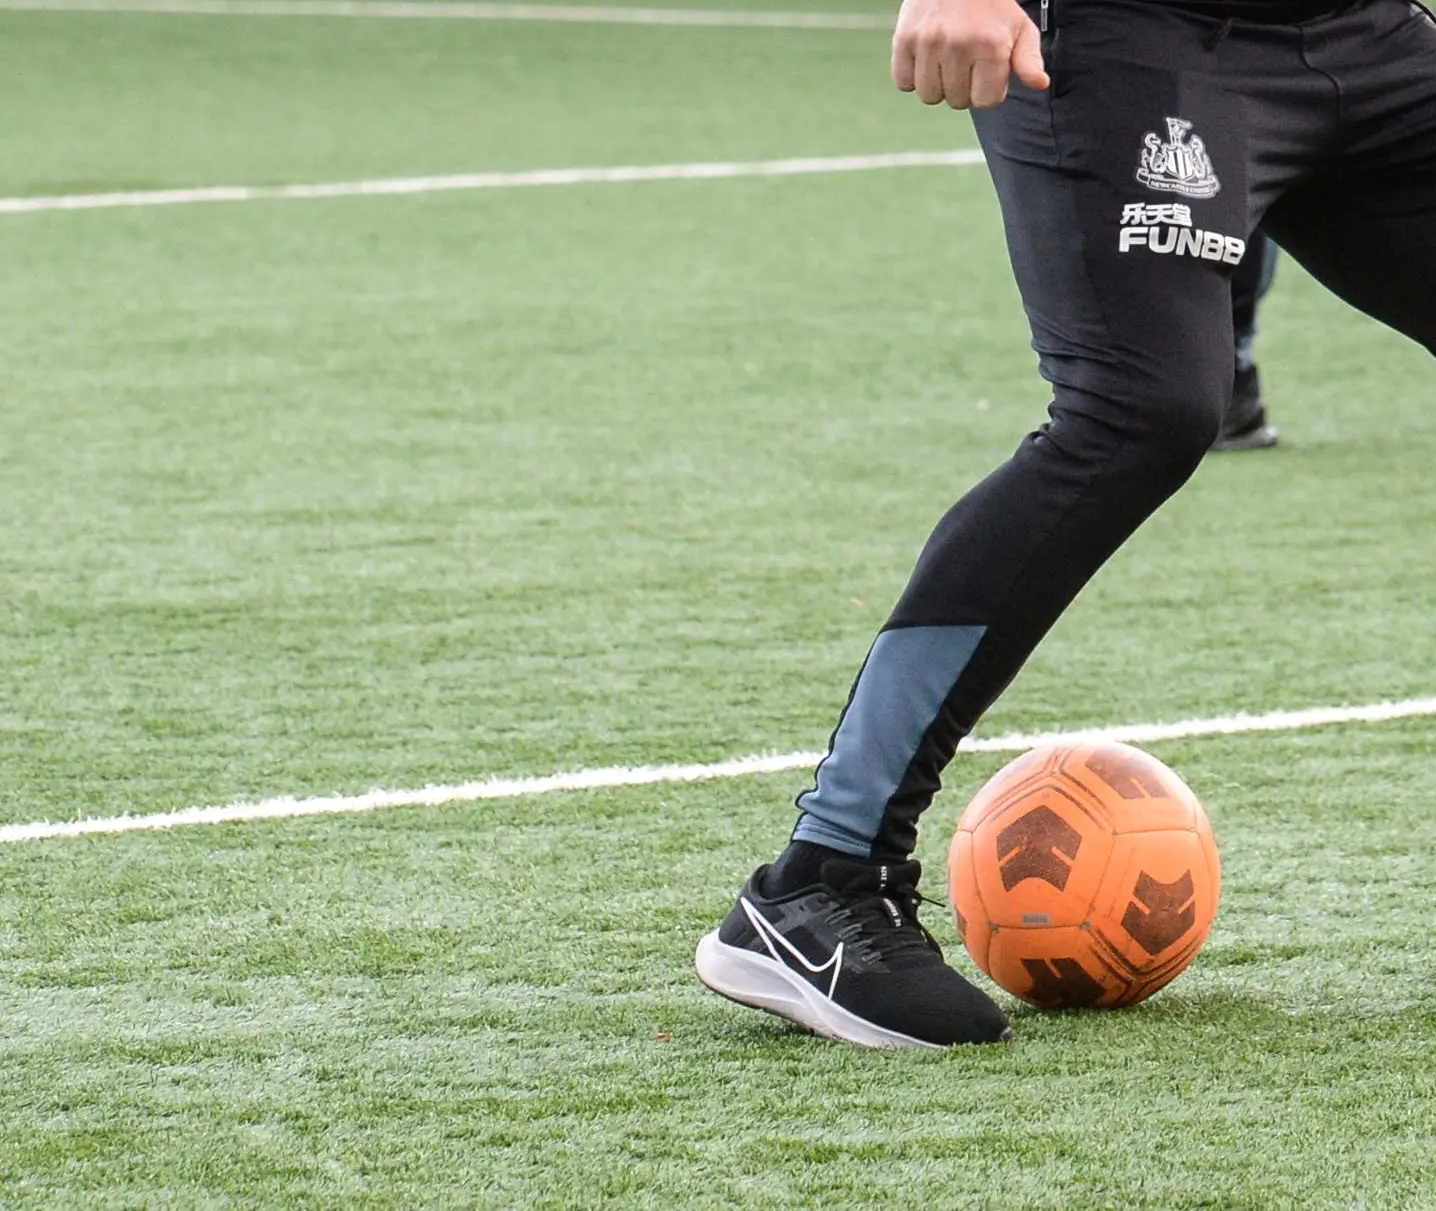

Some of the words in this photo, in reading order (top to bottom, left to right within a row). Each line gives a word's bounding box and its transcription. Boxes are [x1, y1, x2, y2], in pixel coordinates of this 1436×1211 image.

[1119, 202, 1193, 227] 乐天堂
[1118, 226, 1246, 265] FUN88
